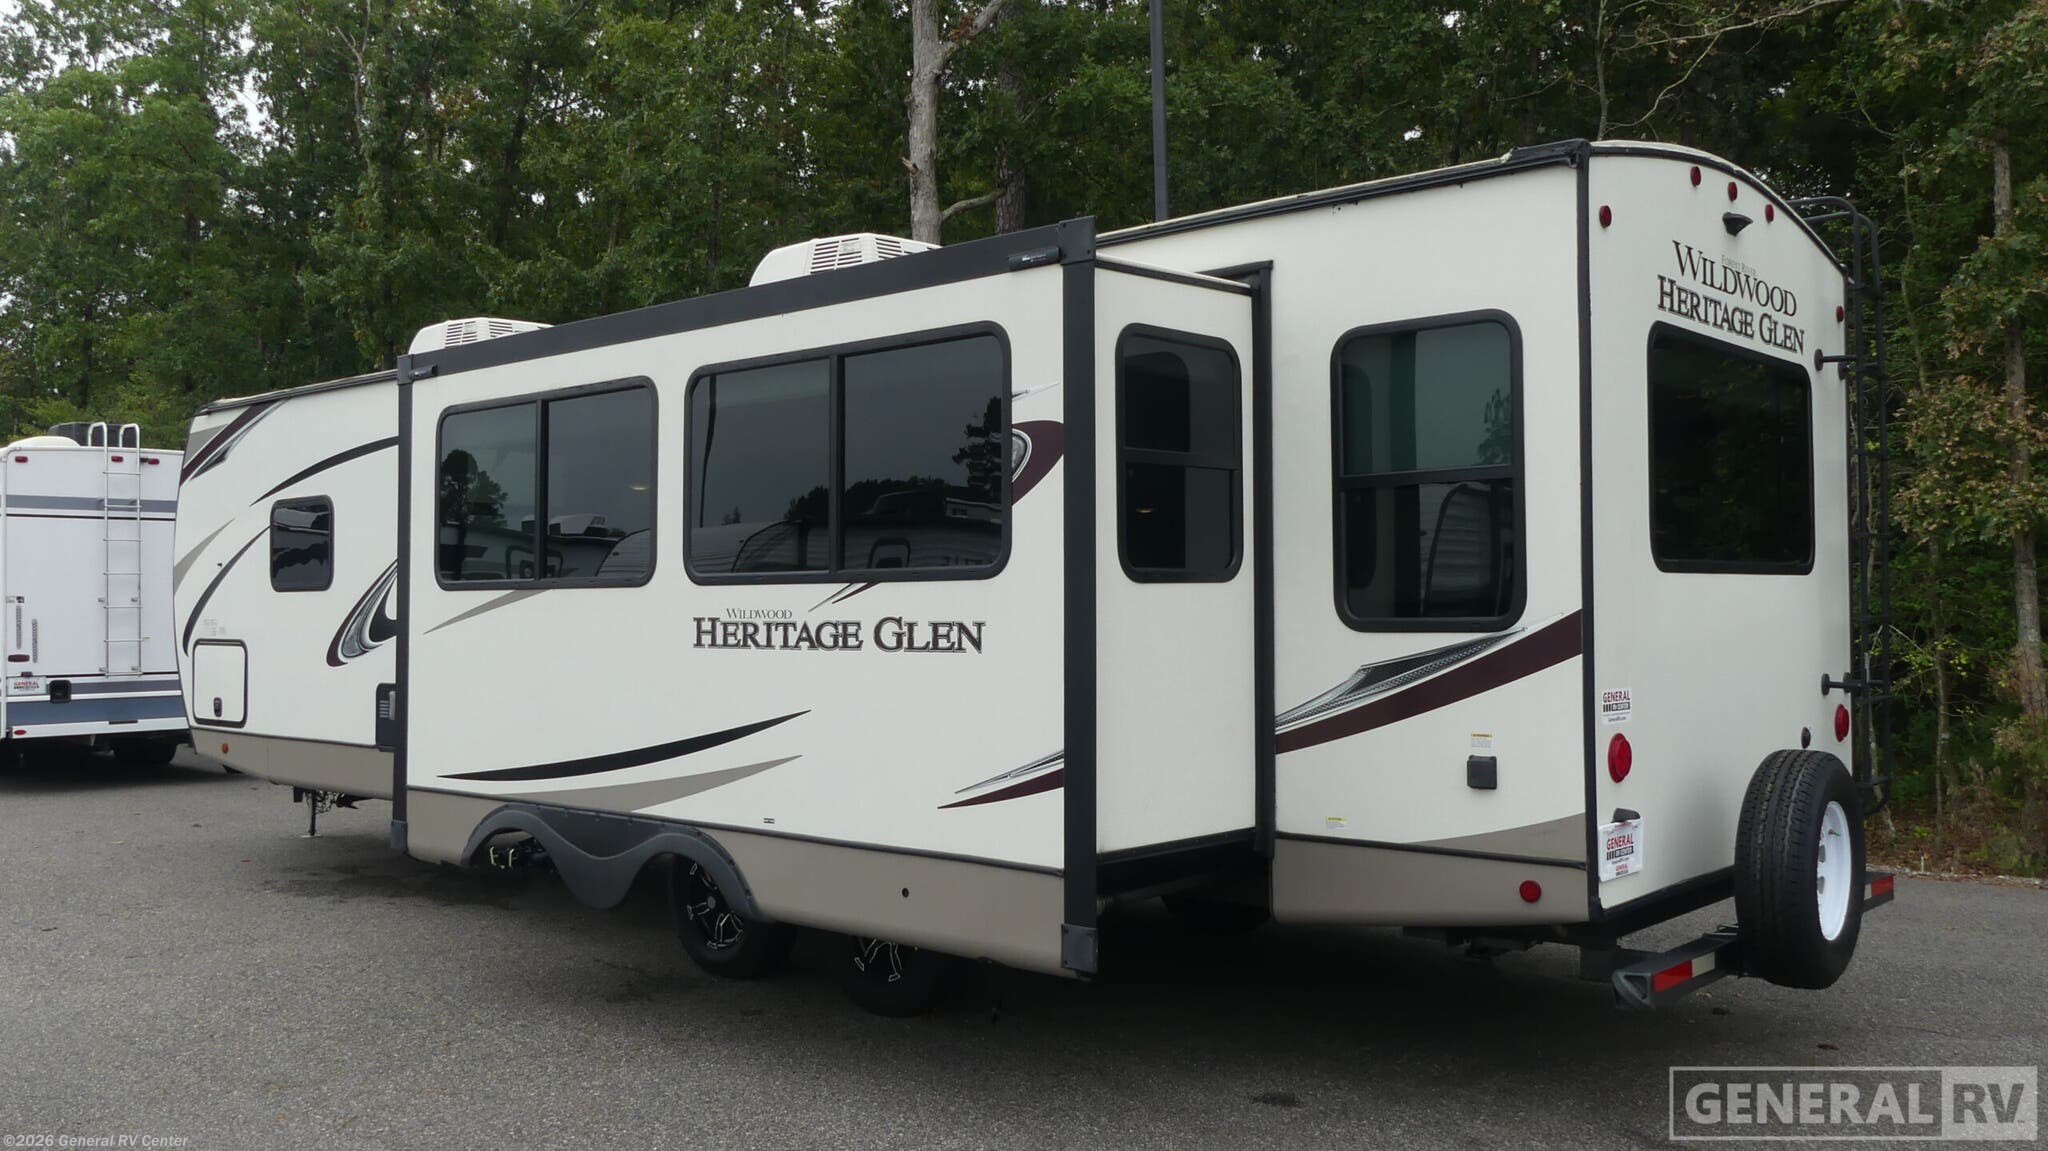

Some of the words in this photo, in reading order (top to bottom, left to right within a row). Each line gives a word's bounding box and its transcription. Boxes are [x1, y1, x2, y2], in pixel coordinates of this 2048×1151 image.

[1672, 240, 1797, 316] WILDWOOD
[1657, 274, 1755, 339] HERITAGE
[1759, 313, 1805, 355] GLEN
[726, 608, 792, 619] WILDWOOD
[693, 617, 864, 651] HERITAGE
[873, 616, 986, 654] GLEN
[1603, 691, 1630, 703] GENERAL
[1607, 834, 1634, 850] GENERAL
